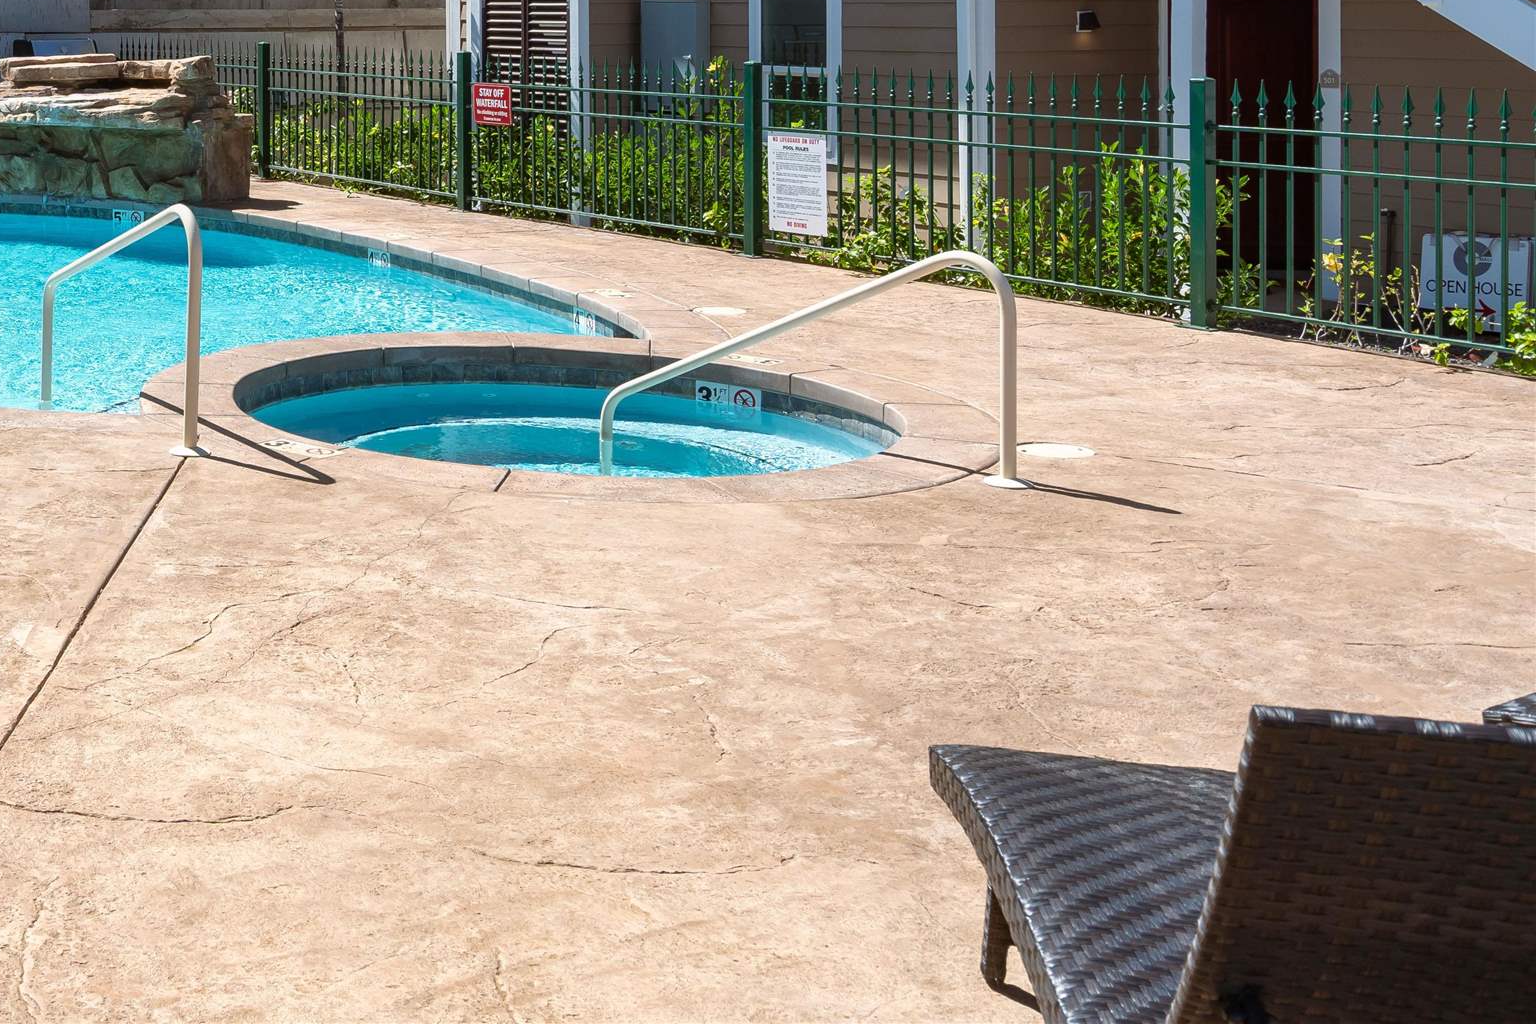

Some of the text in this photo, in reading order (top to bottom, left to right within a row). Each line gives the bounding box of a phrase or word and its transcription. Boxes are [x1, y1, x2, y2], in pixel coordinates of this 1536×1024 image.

[479, 88, 504, 98] STAY OFF
[476, 98, 508, 109] WATERFALL
[1425, 279, 1523, 297] OPEN HOUSE
